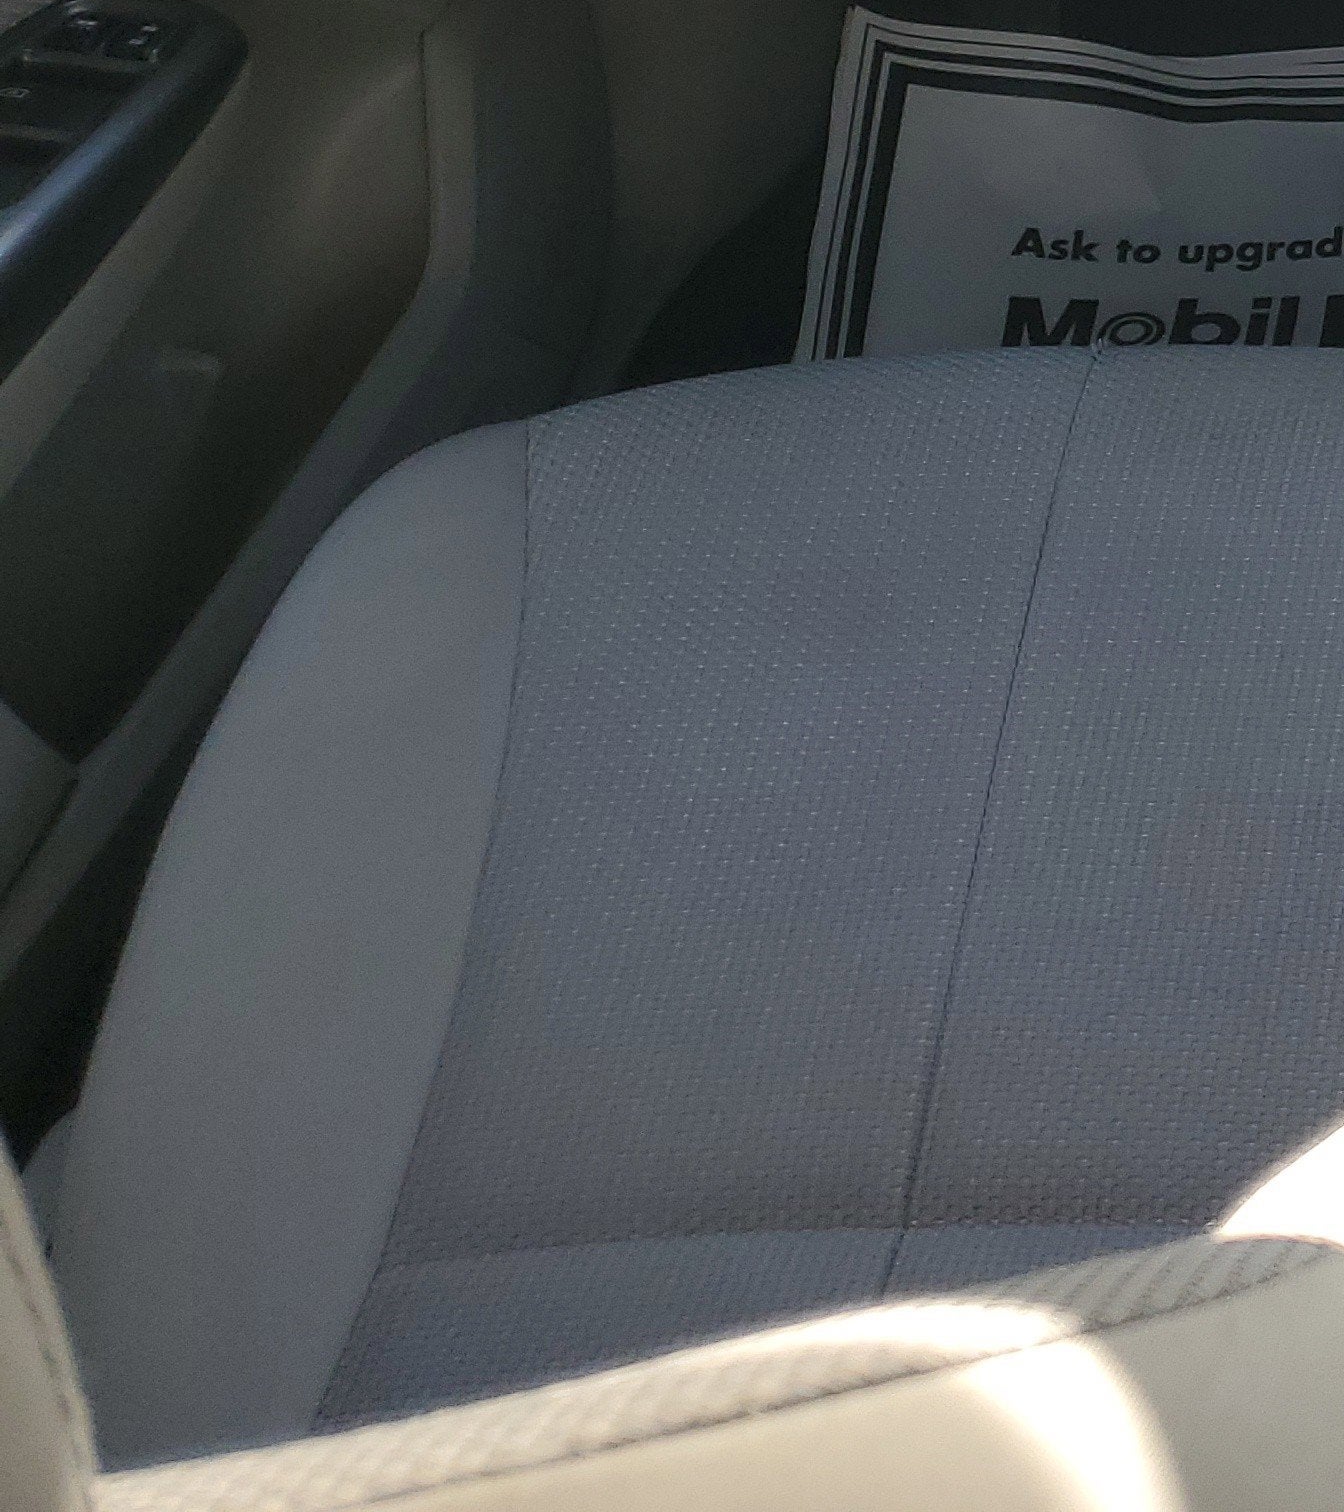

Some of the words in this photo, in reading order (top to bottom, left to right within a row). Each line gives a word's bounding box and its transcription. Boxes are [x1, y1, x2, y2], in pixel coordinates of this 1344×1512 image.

[1011, 227, 1100, 262] Ask
[1116, 237, 1162, 265] to
[1001, 295, 1301, 347] Mobil
